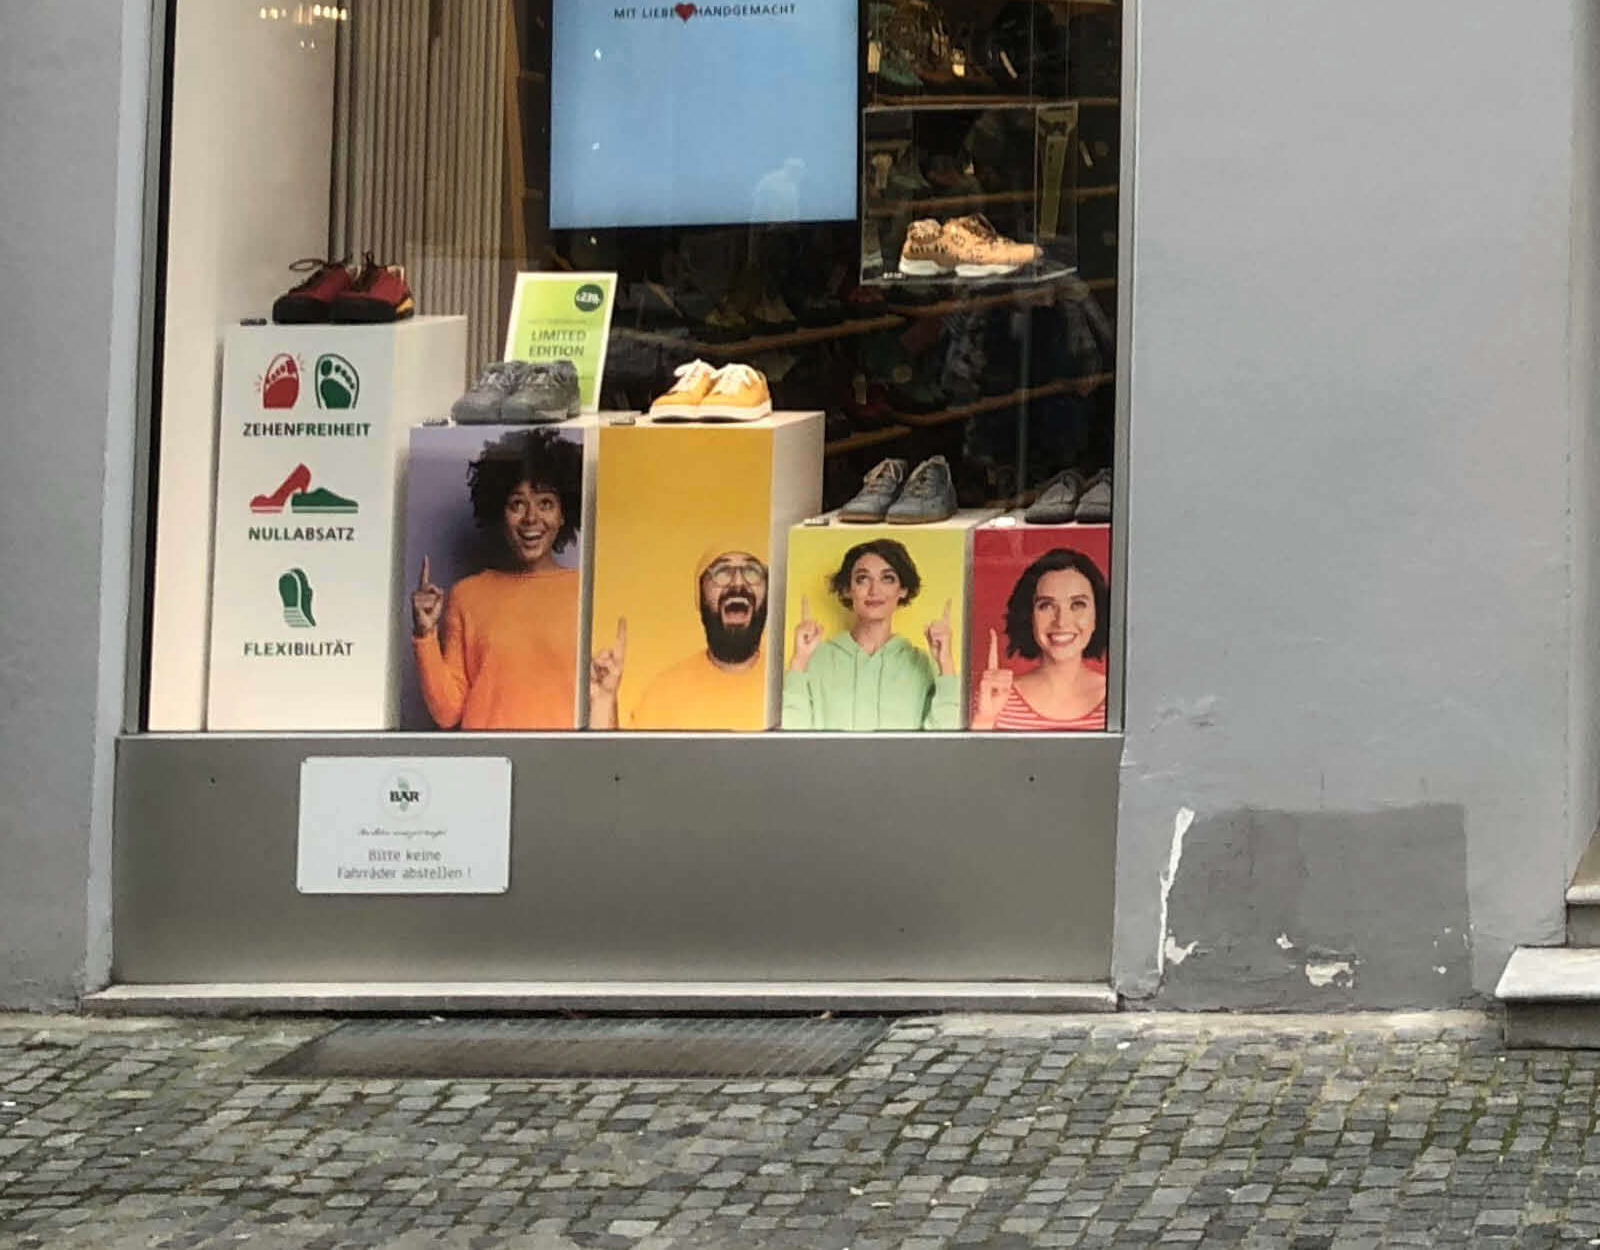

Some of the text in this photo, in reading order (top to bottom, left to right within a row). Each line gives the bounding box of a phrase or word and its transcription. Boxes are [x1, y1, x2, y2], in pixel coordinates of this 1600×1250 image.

[614, 7, 636, 19] MIT
[692, 3, 796, 18] HANDGEMACHT
[531, 329, 587, 343] LIMITED
[528, 345, 585, 358] EDITION
[242, 421, 372, 438] ZEHENFREIHEIT
[248, 526, 355, 543] NULLABSATZ
[243, 638, 353, 657] FLEXIBILITÄT
[368, 849, 442, 862] Bitte keine
[336, 867, 397, 880] Fahrräder
[401, 866, 464, 880] abstellen
